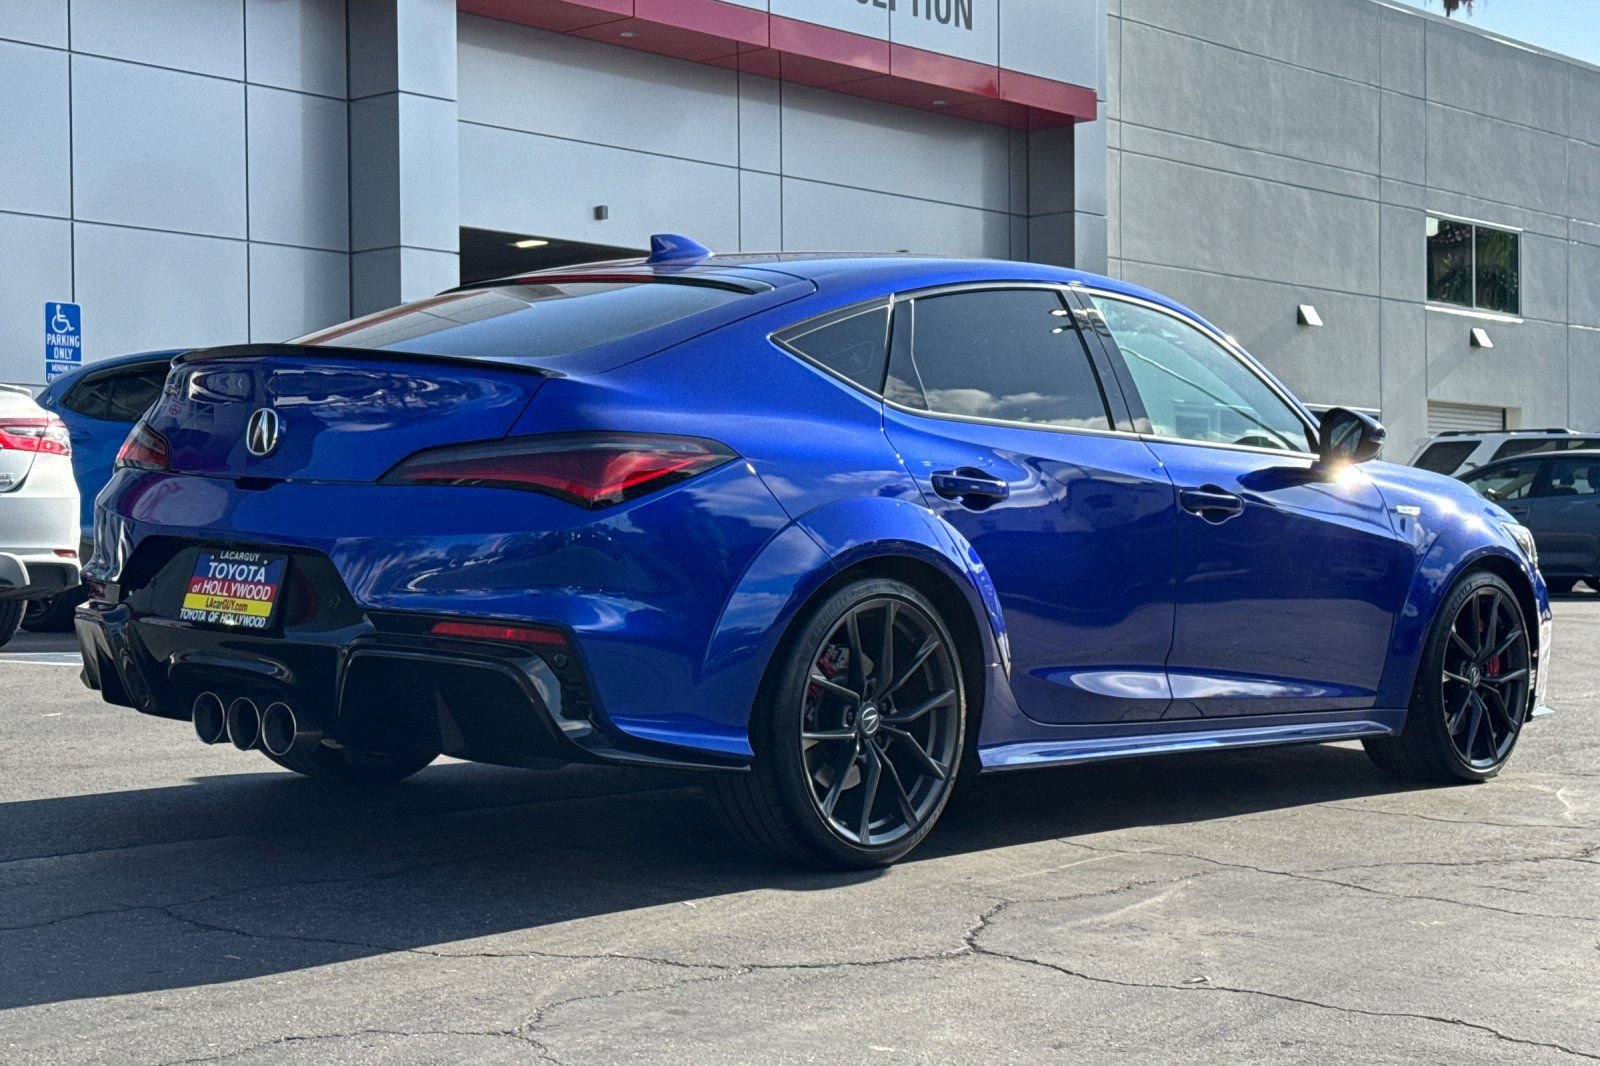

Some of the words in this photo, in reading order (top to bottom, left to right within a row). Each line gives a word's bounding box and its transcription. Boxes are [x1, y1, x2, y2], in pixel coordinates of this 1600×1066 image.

[47, 334, 80, 348] PARKING
[53, 347, 73, 360] ONLY
[220, 551, 260, 561] LACARGUY
[208, 562, 266, 583] TOYOTA
[192, 583, 201, 593] of
[202, 580, 271, 600] HOLLYWOOD
[180, 608, 206, 620] TOYOTA
[207, 612, 219, 622] OF
[220, 615, 266, 628] HOLLYWOOD
